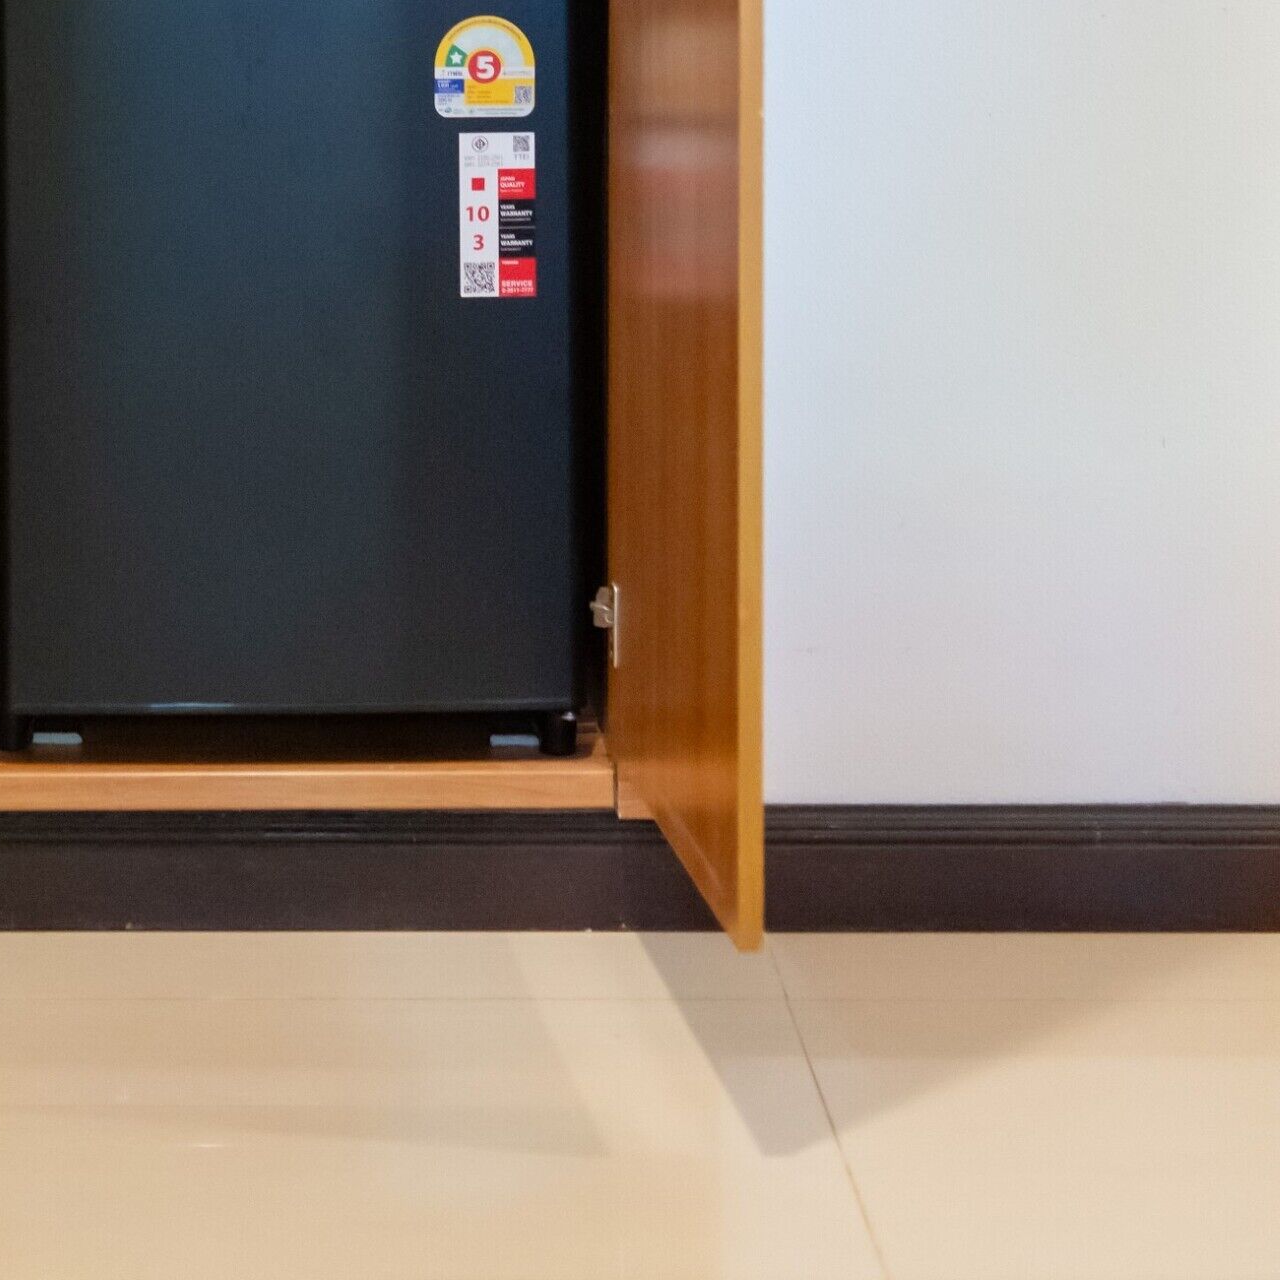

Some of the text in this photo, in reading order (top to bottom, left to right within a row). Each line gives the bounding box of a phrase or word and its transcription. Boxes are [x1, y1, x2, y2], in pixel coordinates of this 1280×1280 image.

[476, 55, 495, 80] 5
[466, 205, 490, 222] 10
[473, 234, 484, 251] 3
